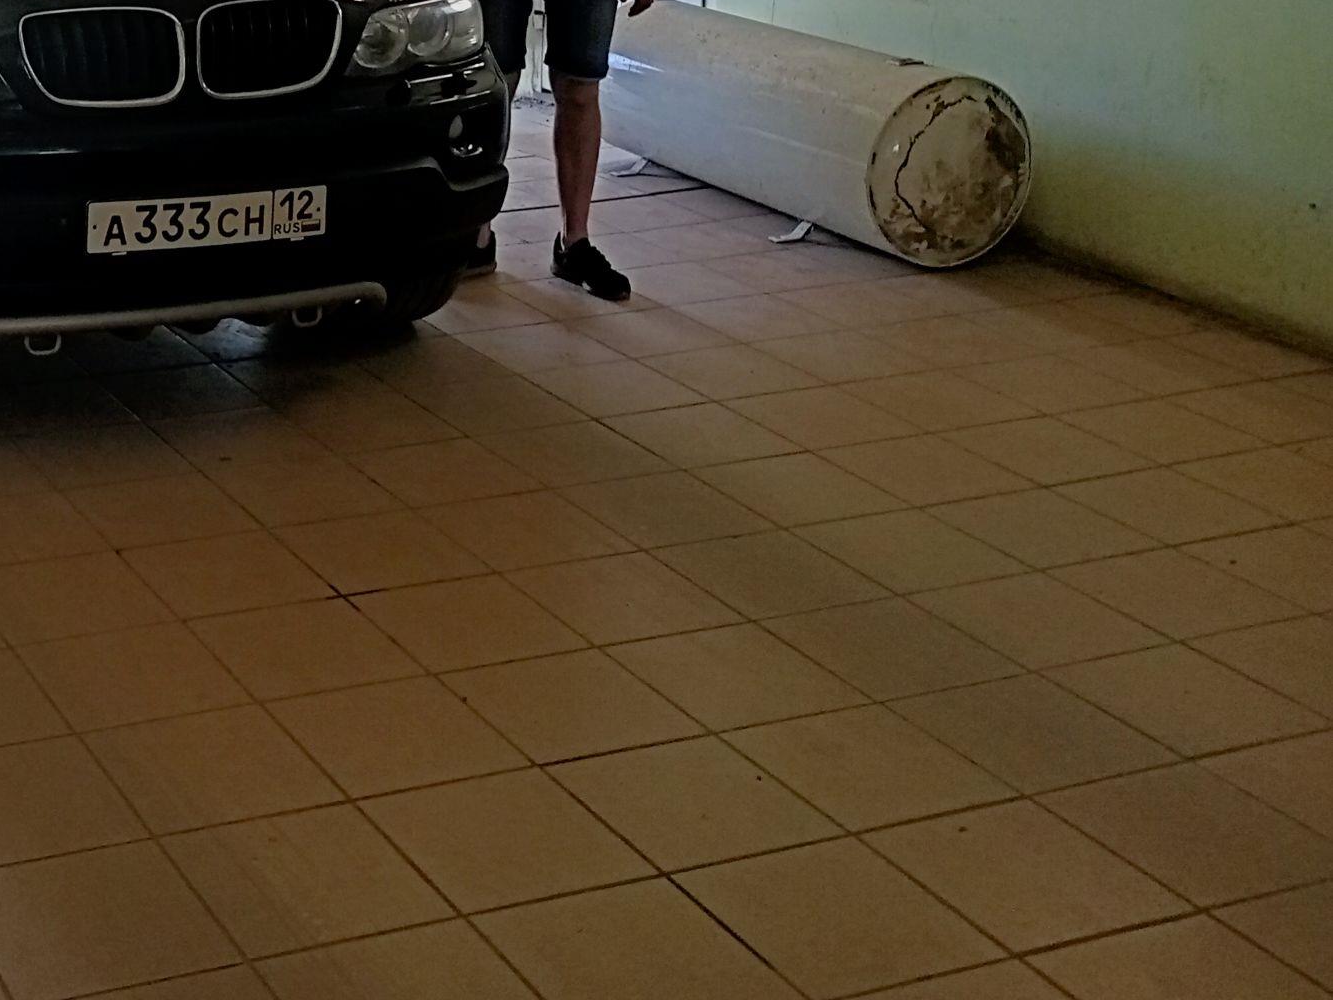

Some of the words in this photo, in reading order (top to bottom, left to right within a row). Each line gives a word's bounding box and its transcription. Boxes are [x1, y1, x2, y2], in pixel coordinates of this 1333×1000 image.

[103, 201, 266, 246] А333СН
[279, 190, 315, 221] 12
[274, 222, 300, 235] RUS
